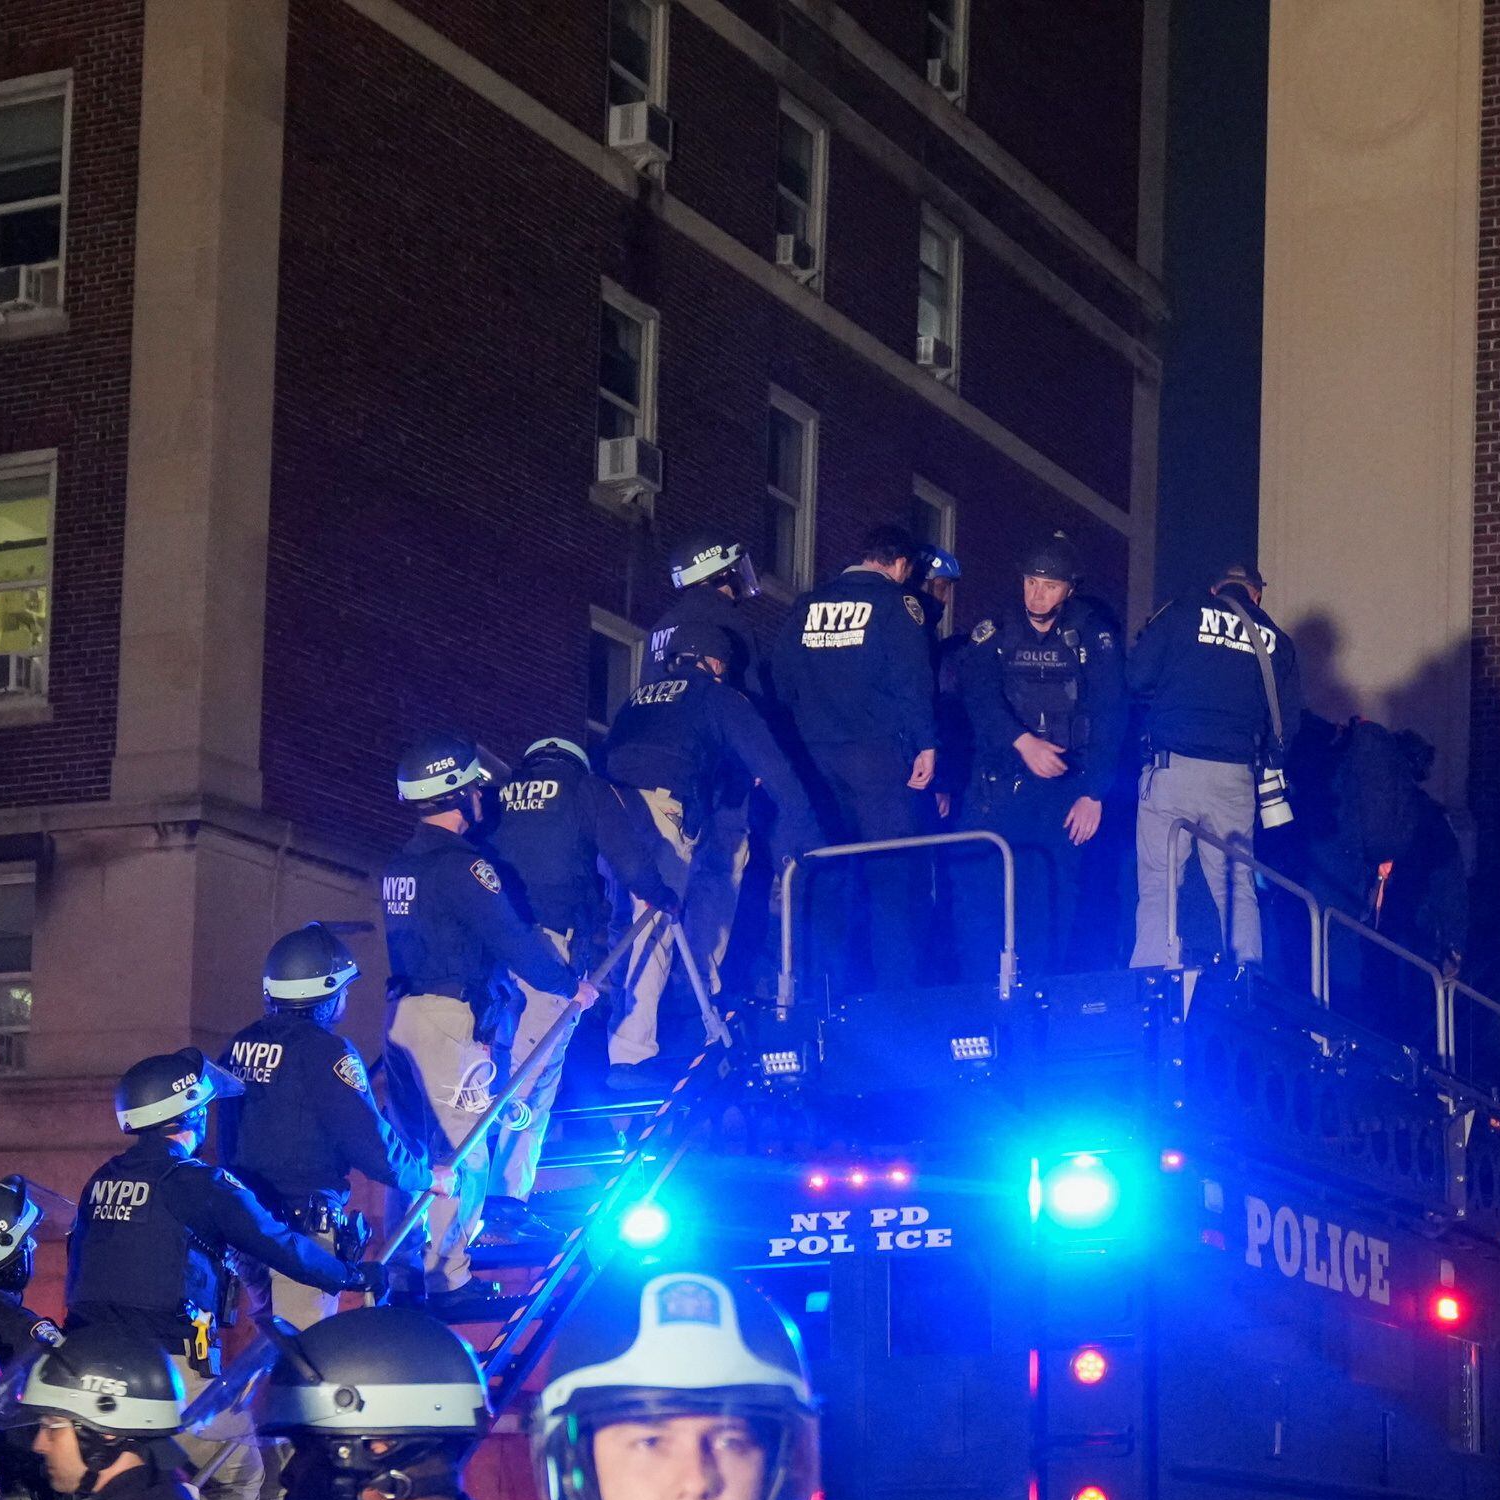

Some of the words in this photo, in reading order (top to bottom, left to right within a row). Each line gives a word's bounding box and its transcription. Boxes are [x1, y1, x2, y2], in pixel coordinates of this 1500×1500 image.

[804, 601, 873, 631] NYPD
[1015, 650, 1058, 662] POLICE
[426, 757, 456, 775] 7256
[500, 780, 559, 802] NYPD
[506, 799, 545, 811] POLICE
[382, 877, 416, 901] NYPD
[387, 902, 409, 914] POLICE
[229, 1041, 283, 1069] NYPD
[172, 1072, 198, 1093] 6749
[232, 1066, 272, 1083] POLICE
[89, 1180, 150, 1206] NYPD
[92, 1205, 133, 1221] POLICE
[790, 1210, 851, 1233] NY
[870, 1206, 930, 1228] PD
[768, 1234, 855, 1257] POL
[876, 1228, 952, 1251] ICE
[1244, 1195, 1390, 1306] POLICE
